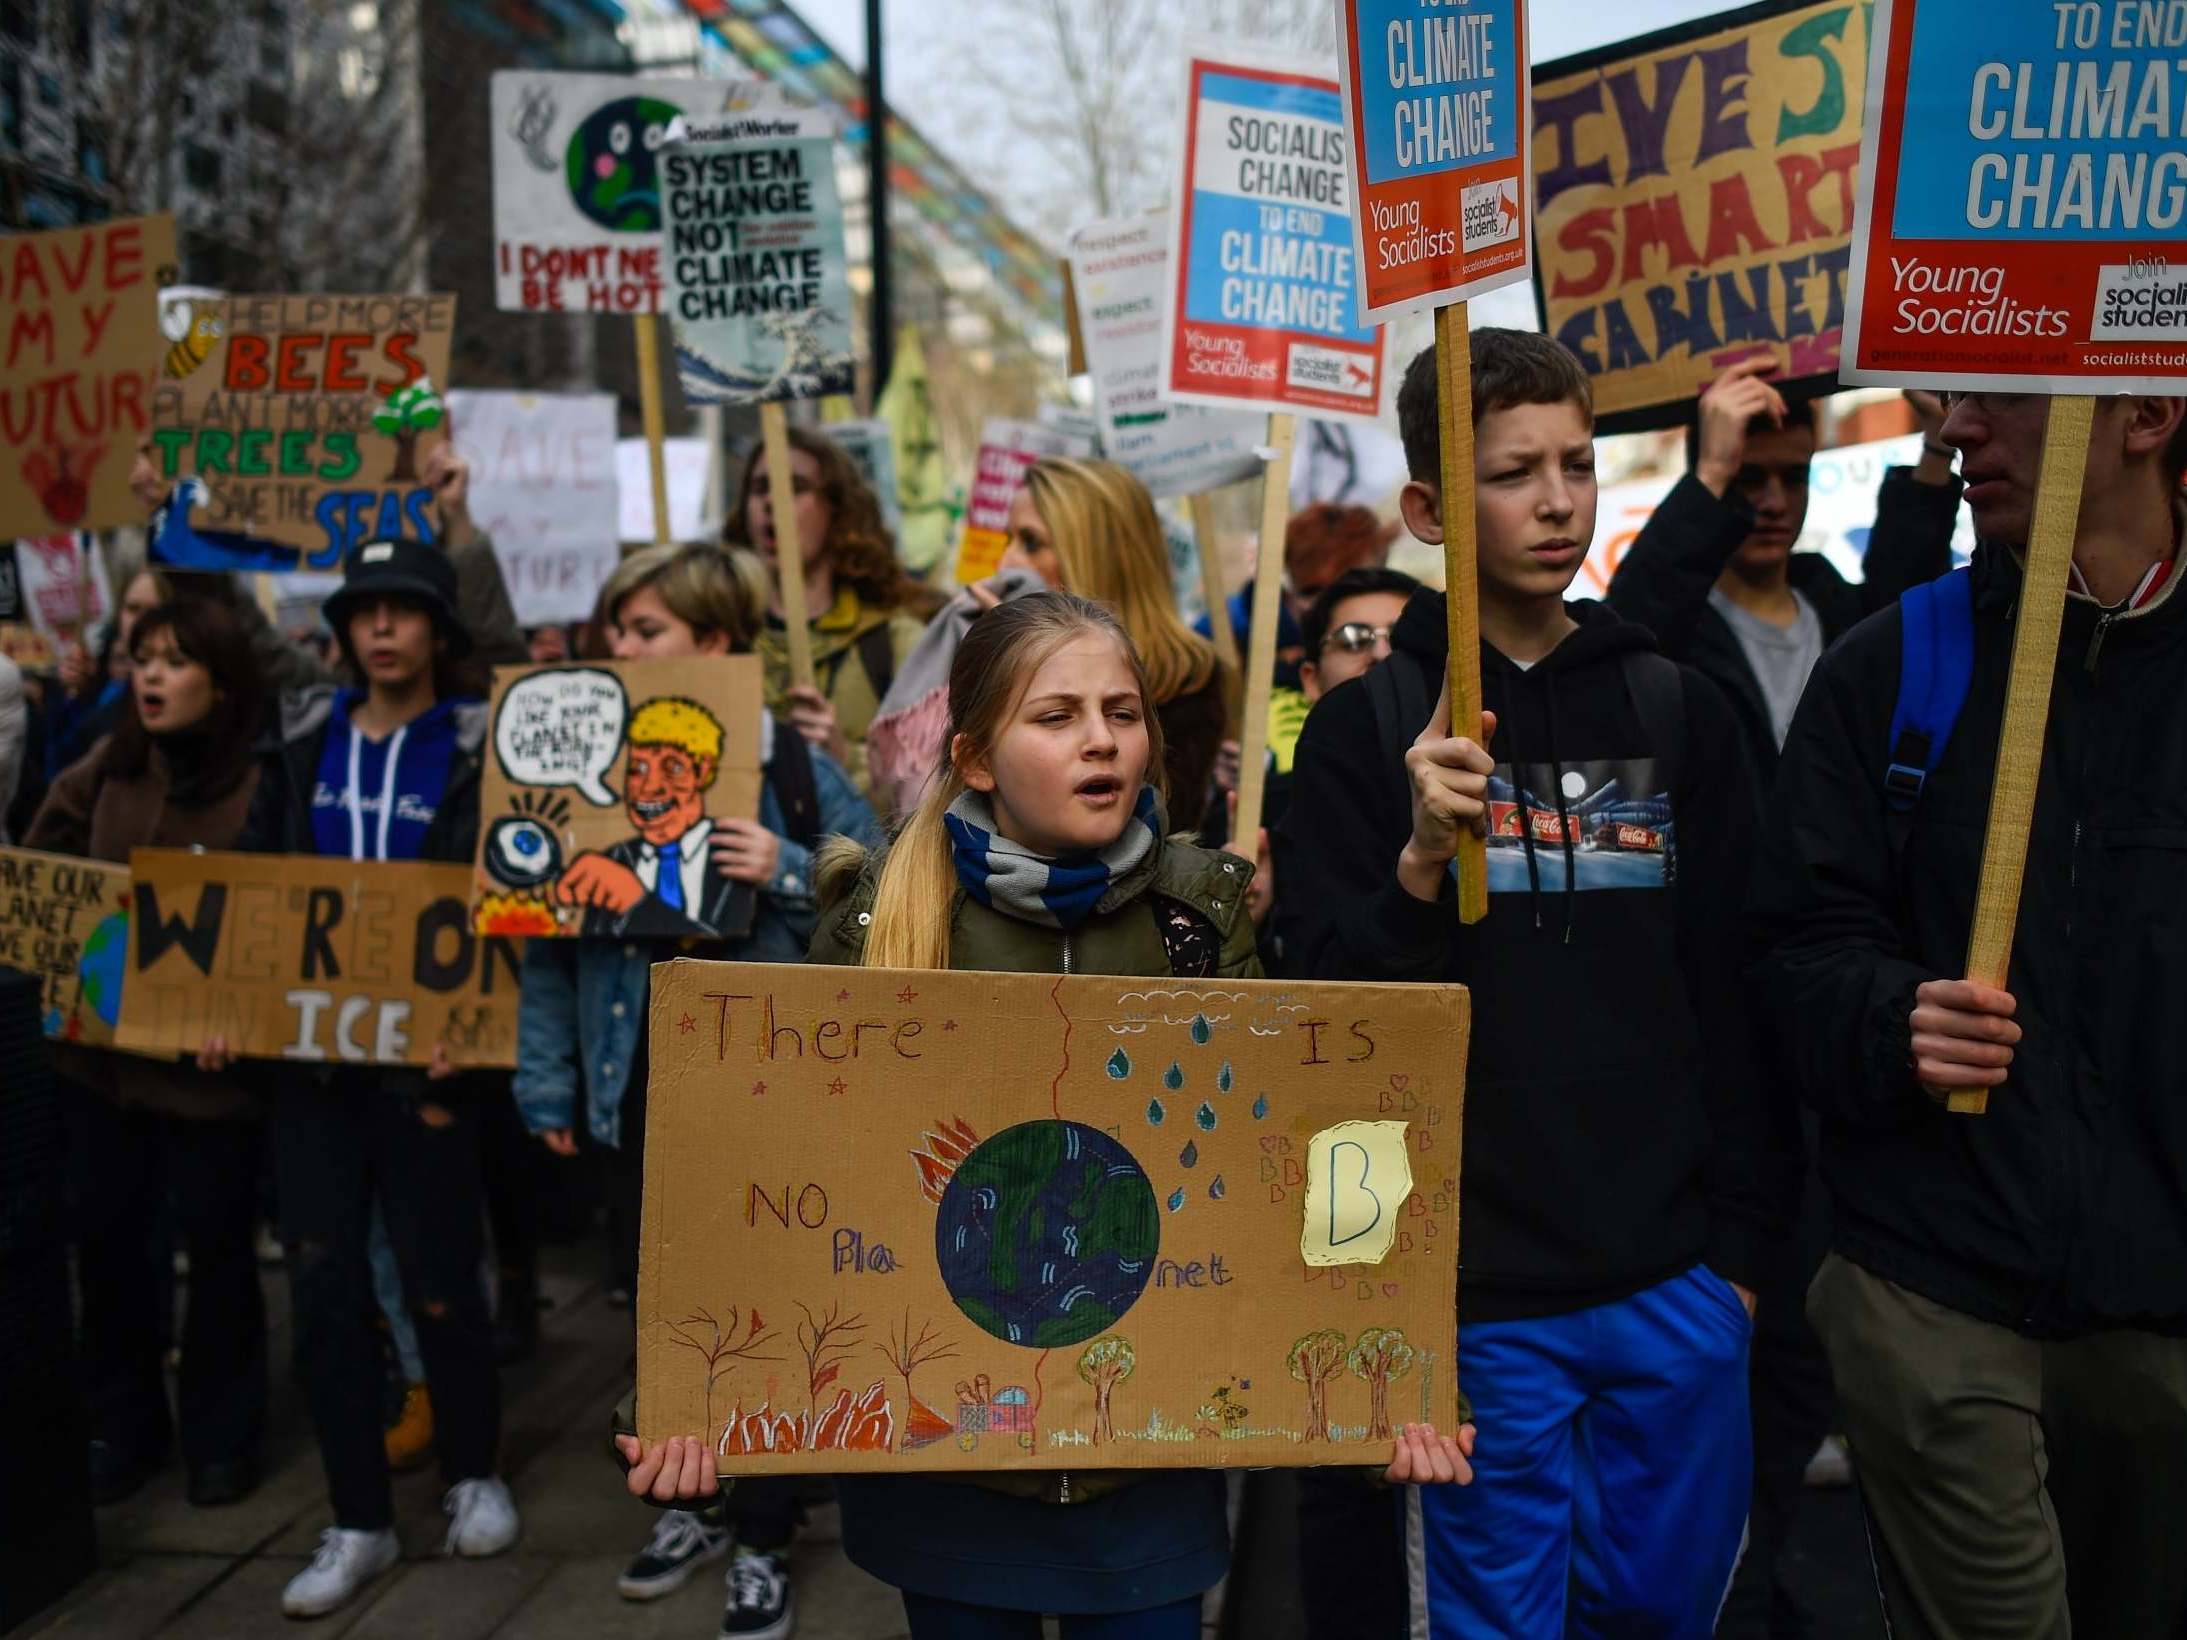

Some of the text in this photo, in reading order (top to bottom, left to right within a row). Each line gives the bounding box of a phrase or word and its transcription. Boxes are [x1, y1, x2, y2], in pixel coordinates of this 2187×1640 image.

[2053, 0, 2187, 49] TO END
[1387, 14, 1496, 89] CLIMATE
[1776, 3, 1873, 147] S
[1227, 115, 1346, 166] SOCIALIS
[1394, 90, 1495, 168] CHANGE
[667, 149, 801, 186] SYSTEM
[1239, 158, 1344, 206] CHANGE
[1966, 152, 2187, 229] CHANG
[671, 182, 813, 220] CHANGE
[1258, 204, 1323, 237] TO END
[1369, 199, 1420, 235] Young
[1551, 141, 1862, 299] SMART
[674, 221, 739, 254] NOT
[1378, 225, 1456, 270] Socialists
[1465, 215, 1497, 241] students
[0, 226, 144, 303] AVE
[499, 243, 511, 275] I
[676, 248, 821, 287] CLIMATE
[1220, 230, 1351, 287] CLIMATE
[1890, 256, 2005, 305] Young
[2122, 251, 2167, 281] Join
[230, 299, 449, 333] HELP MORE
[521, 279, 664, 315] BE HOT
[680, 282, 820, 322] CHANGE
[1220, 277, 1347, 333] CHANGE
[1555, 243, 1851, 376] CABINET
[1892, 297, 2070, 337] Socialists
[225, 331, 427, 397] BEES
[1184, 328, 1245, 361] Young
[1187, 352, 1278, 382] Socialists
[2083, 352, 2187, 366] socialiststud
[0, 370, 158, 446] UTUR
[157, 386, 373, 433] PLANT MORE
[155, 429, 361, 480] TREES
[277, 484, 314, 525] THE
[307, 487, 436, 568] SEAS
[0, 855, 45, 896] AVE
[135, 880, 396, 984] WE'RE
[281, 988, 413, 1063] ICE
[703, 994, 1374, 1064] There IS
[751, 1184, 828, 1229] NO
[1329, 1141, 1381, 1246] B
[832, 1228, 1234, 1289] Pla net
